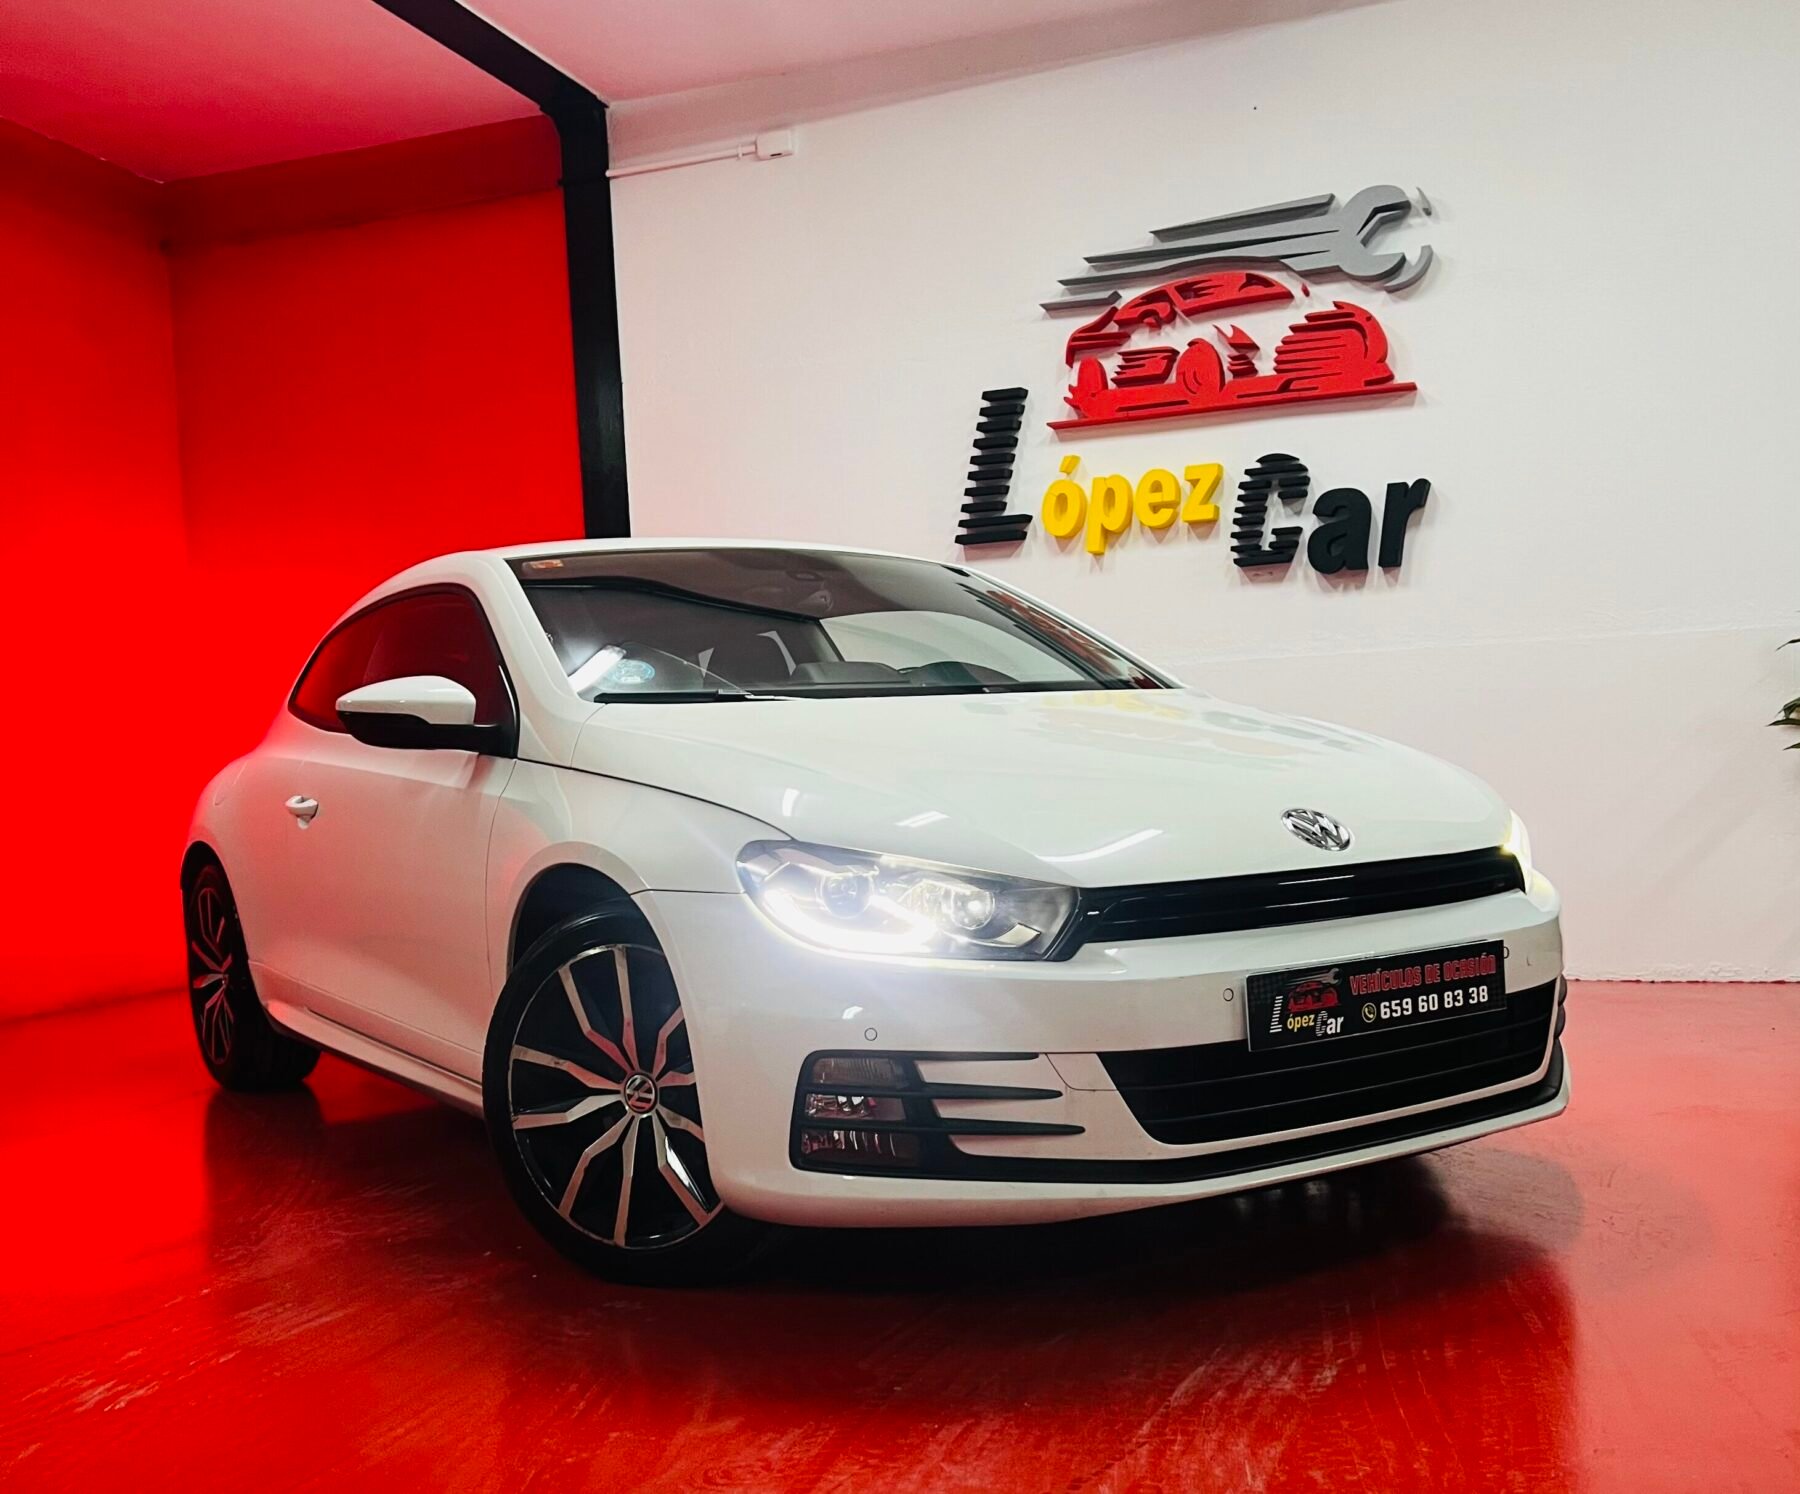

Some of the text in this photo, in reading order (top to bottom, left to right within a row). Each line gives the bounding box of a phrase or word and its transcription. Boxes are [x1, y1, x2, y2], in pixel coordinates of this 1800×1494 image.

[955, 387, 1431, 575] López Car
[1349, 953, 1496, 996] VEHÍCULOS DE OCASIÓN
[1380, 985, 1489, 1019] 659 60 83 38
